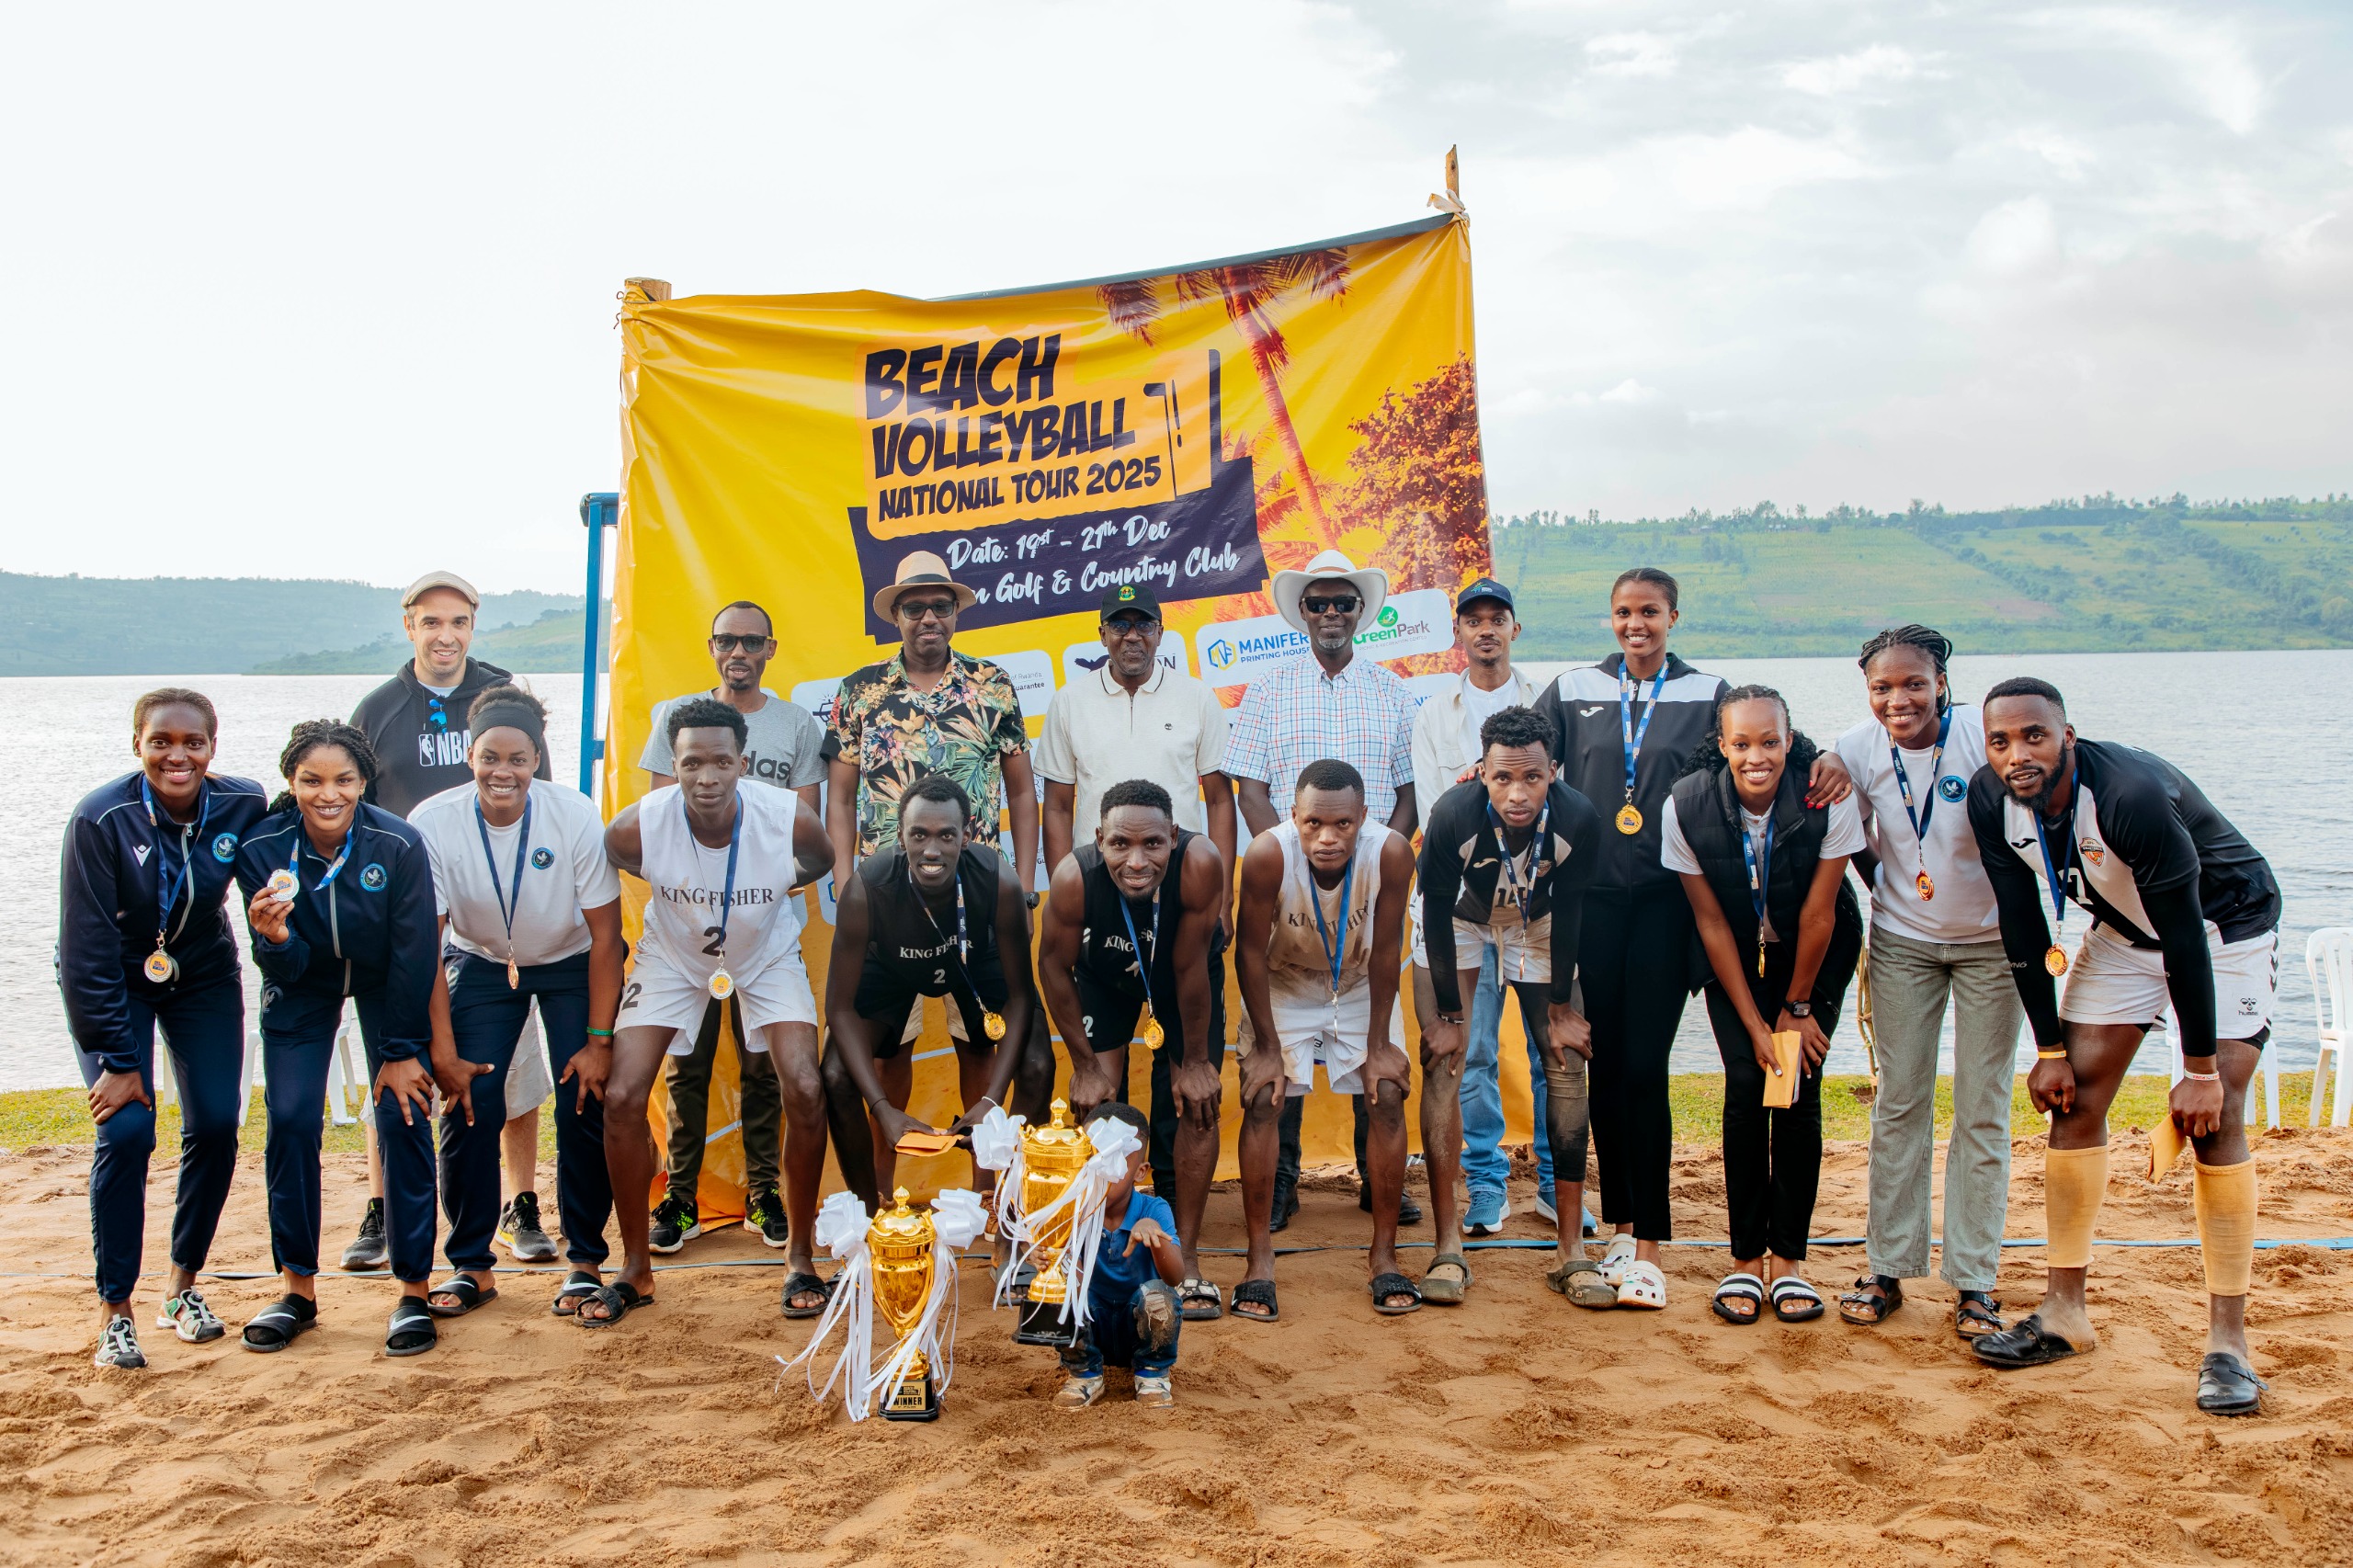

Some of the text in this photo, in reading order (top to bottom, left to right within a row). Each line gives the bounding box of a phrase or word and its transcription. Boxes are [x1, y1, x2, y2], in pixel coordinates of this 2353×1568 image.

[865, 334, 1061, 420] BEACH
[872, 397, 1135, 479] VOLLEYBALL
[879, 455, 1162, 522] NATIONAL TOUR 2025
[946, 536, 1008, 570] Date:
[1122, 515, 1171, 547] Dec
[995, 572, 1044, 605] Golf
[1051, 569, 1073, 595] &
[1080, 555, 1177, 592] Country
[1184, 541, 1241, 577] Club
[1240, 652, 1281, 664] PRINTING
[1015, 682, 1045, 691] uarantee
[437, 730, 472, 766] NBA
[747, 751, 790, 780] das
[660, 886, 705, 904] KING
[1288, 913, 1321, 933] KIN
[701, 926, 727, 957] 2
[900, 946, 933, 959] KING
[1104, 935, 1134, 952] KING
[934, 969, 945, 983] 2
[622, 983, 642, 1010] 2
[1083, 1015, 1094, 1038] 2
